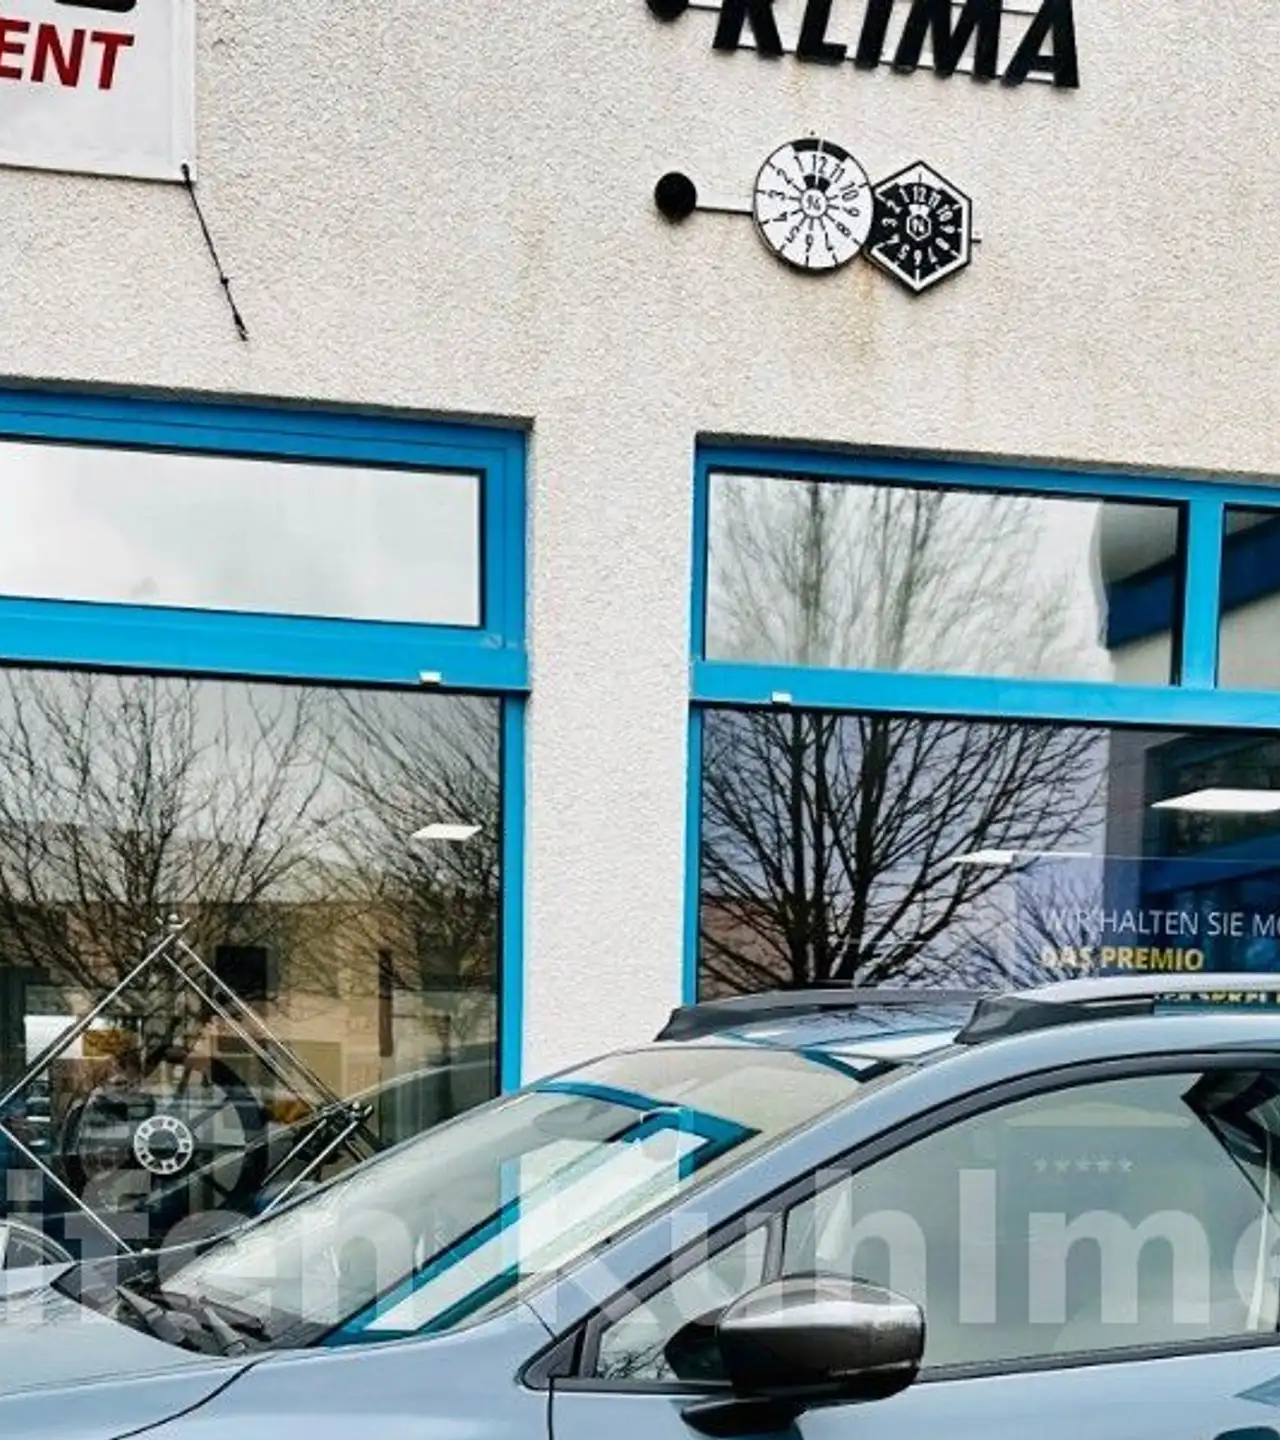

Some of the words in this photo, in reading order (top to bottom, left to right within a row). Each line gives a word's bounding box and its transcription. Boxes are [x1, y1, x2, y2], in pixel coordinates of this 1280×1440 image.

[712, 0, 1080, 88] KLIMA
[1050, 908, 1096, 934] WIR
[1100, 909, 1199, 936] HALTEN
[1206, 910, 1244, 938] SIE
[1041, 946, 1094, 970] DAS
[1100, 946, 1205, 972] PREMIO
